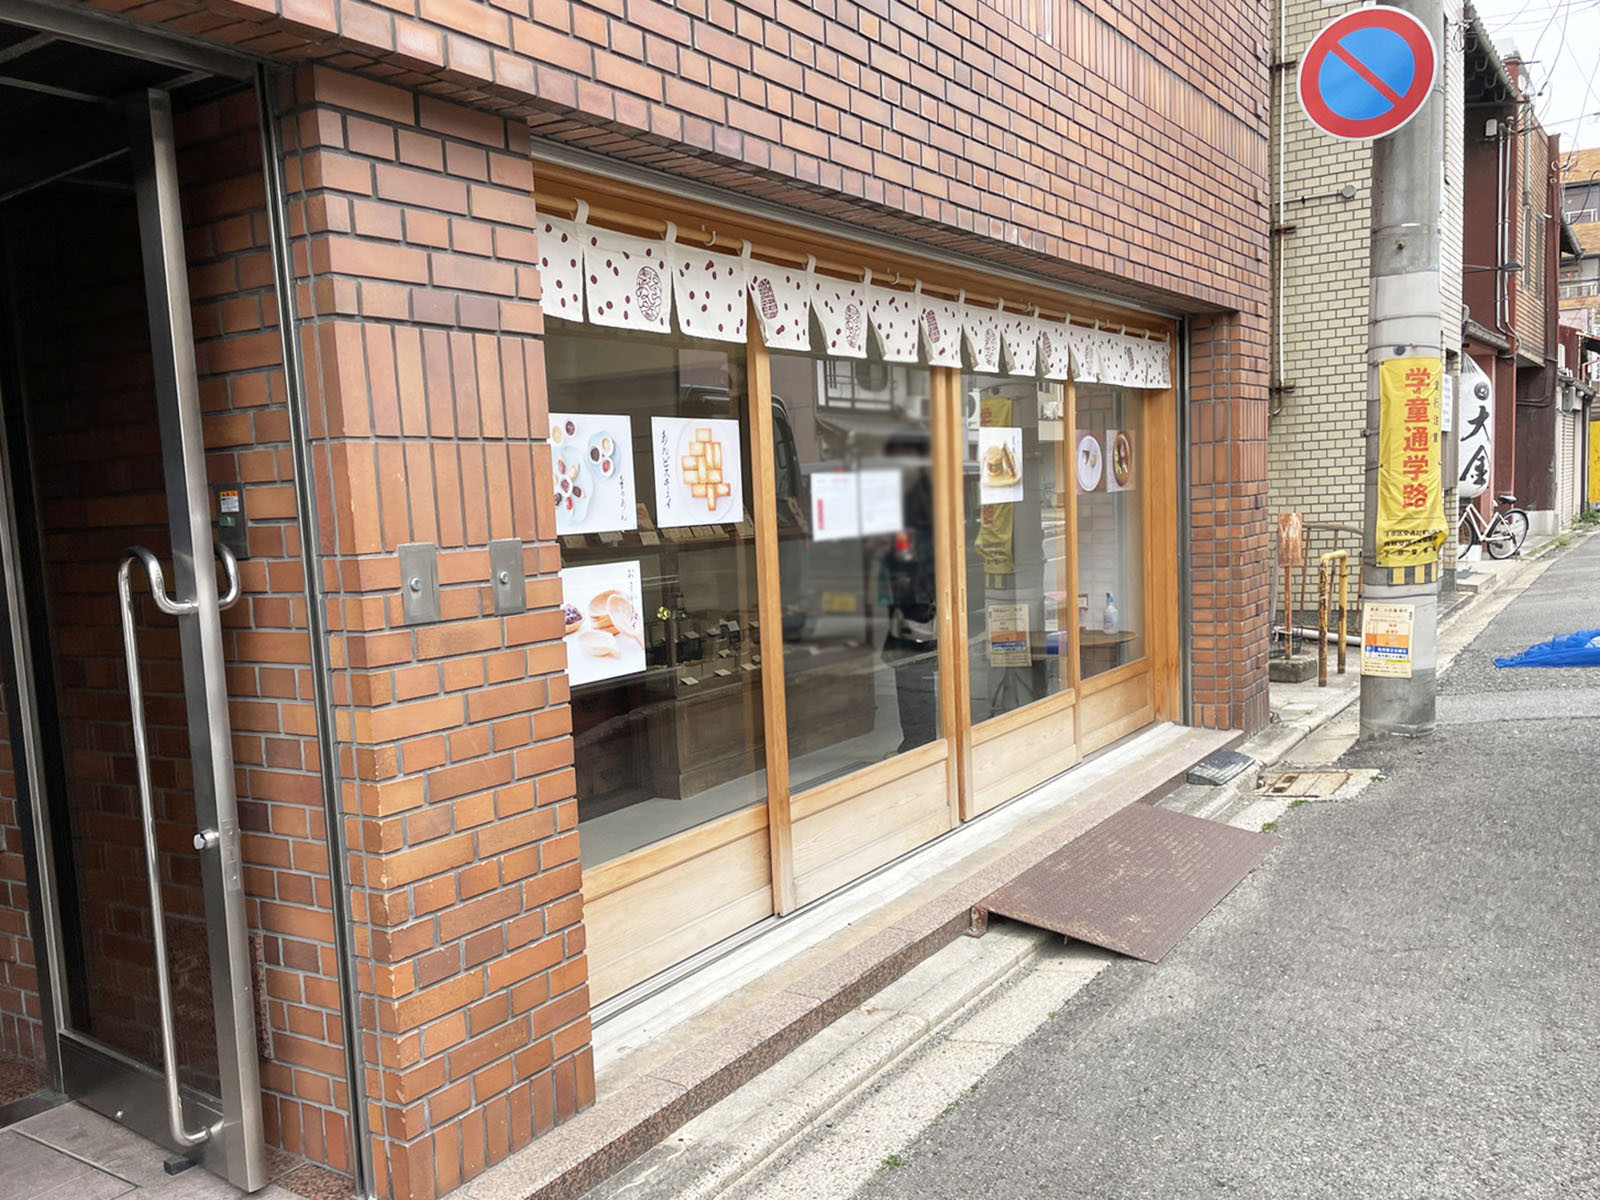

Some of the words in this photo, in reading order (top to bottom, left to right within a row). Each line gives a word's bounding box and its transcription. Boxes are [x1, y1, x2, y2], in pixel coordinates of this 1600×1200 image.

[1402, 367, 1431, 510] 学童通学路
[1459, 404, 1491, 487] 大金
